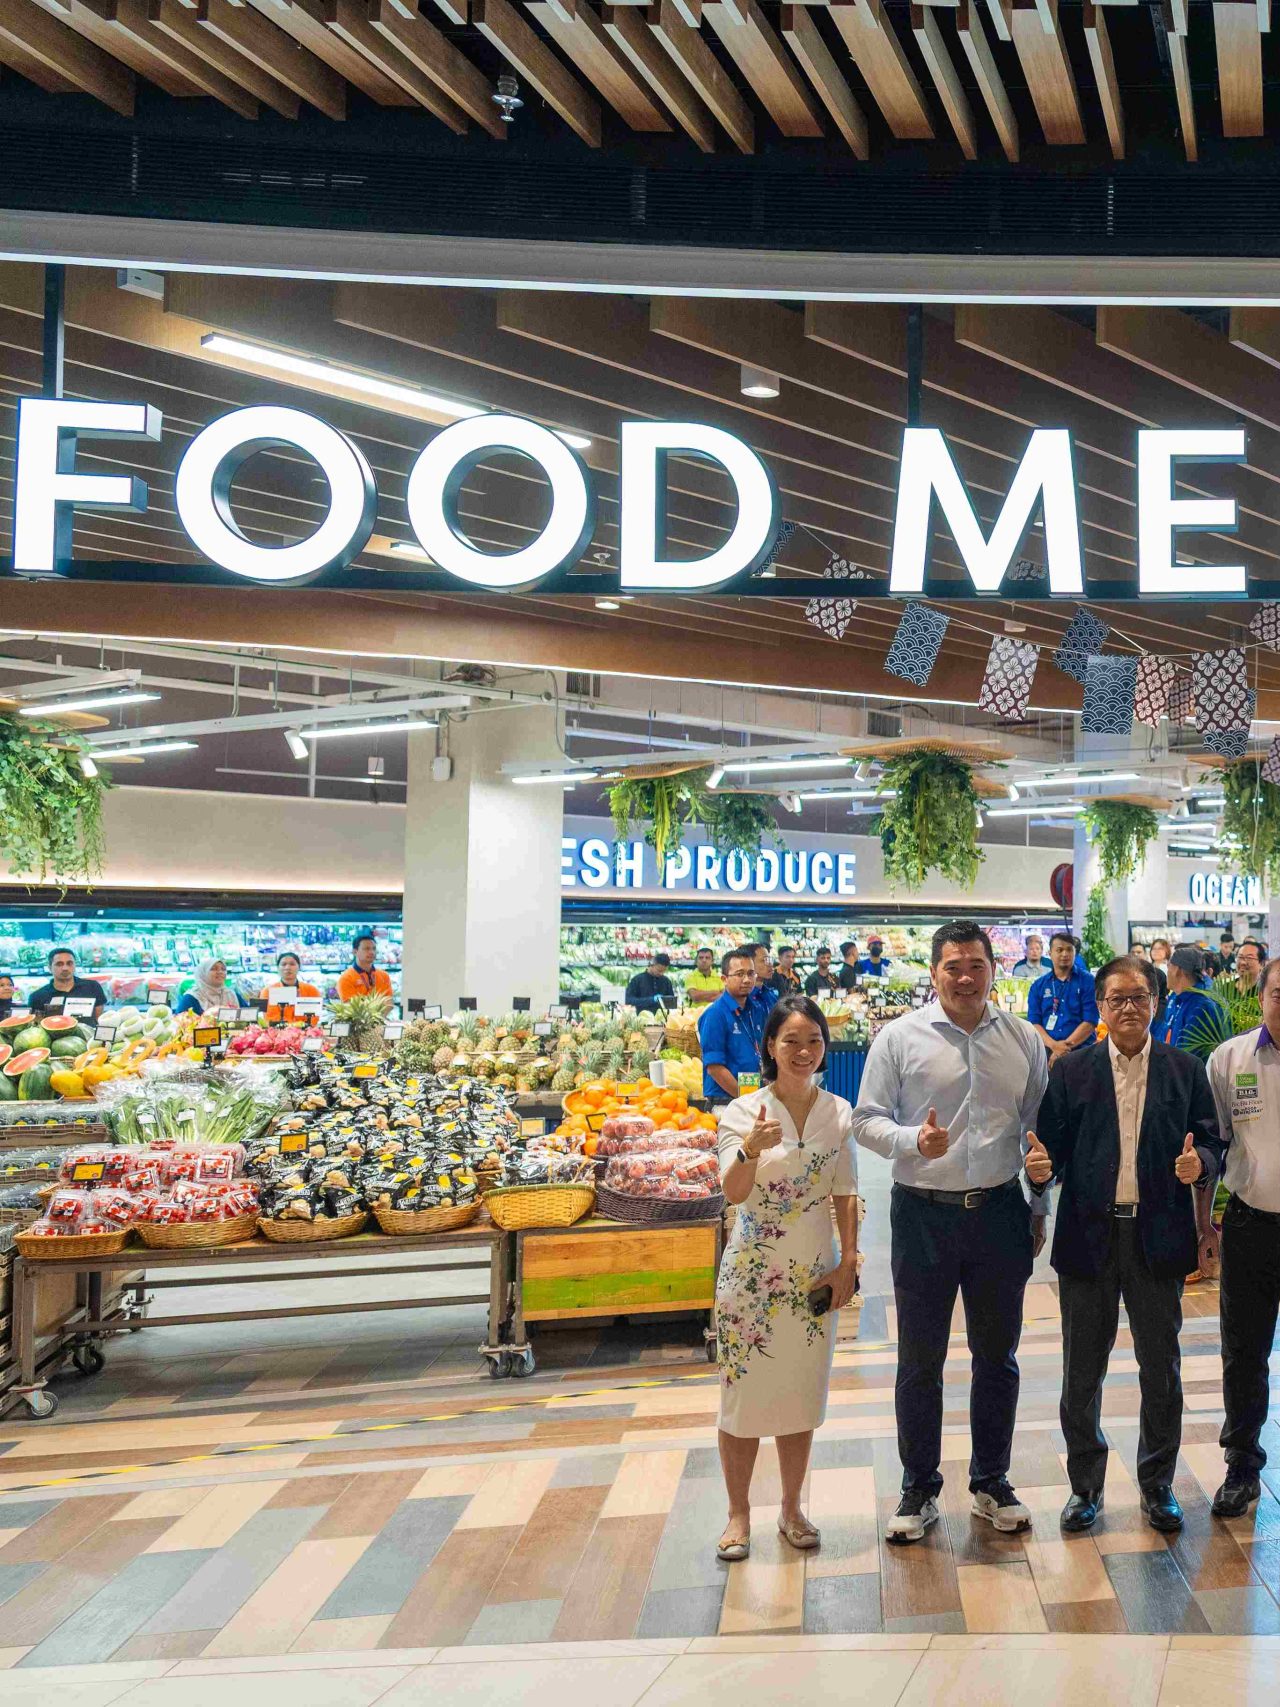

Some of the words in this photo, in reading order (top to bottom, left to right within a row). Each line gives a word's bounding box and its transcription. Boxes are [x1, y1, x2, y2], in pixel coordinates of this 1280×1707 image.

[13, 397, 781, 592] FOOD
[664, 844, 856, 894] PRODUCE
[1190, 872, 1261, 906] OCEAN
